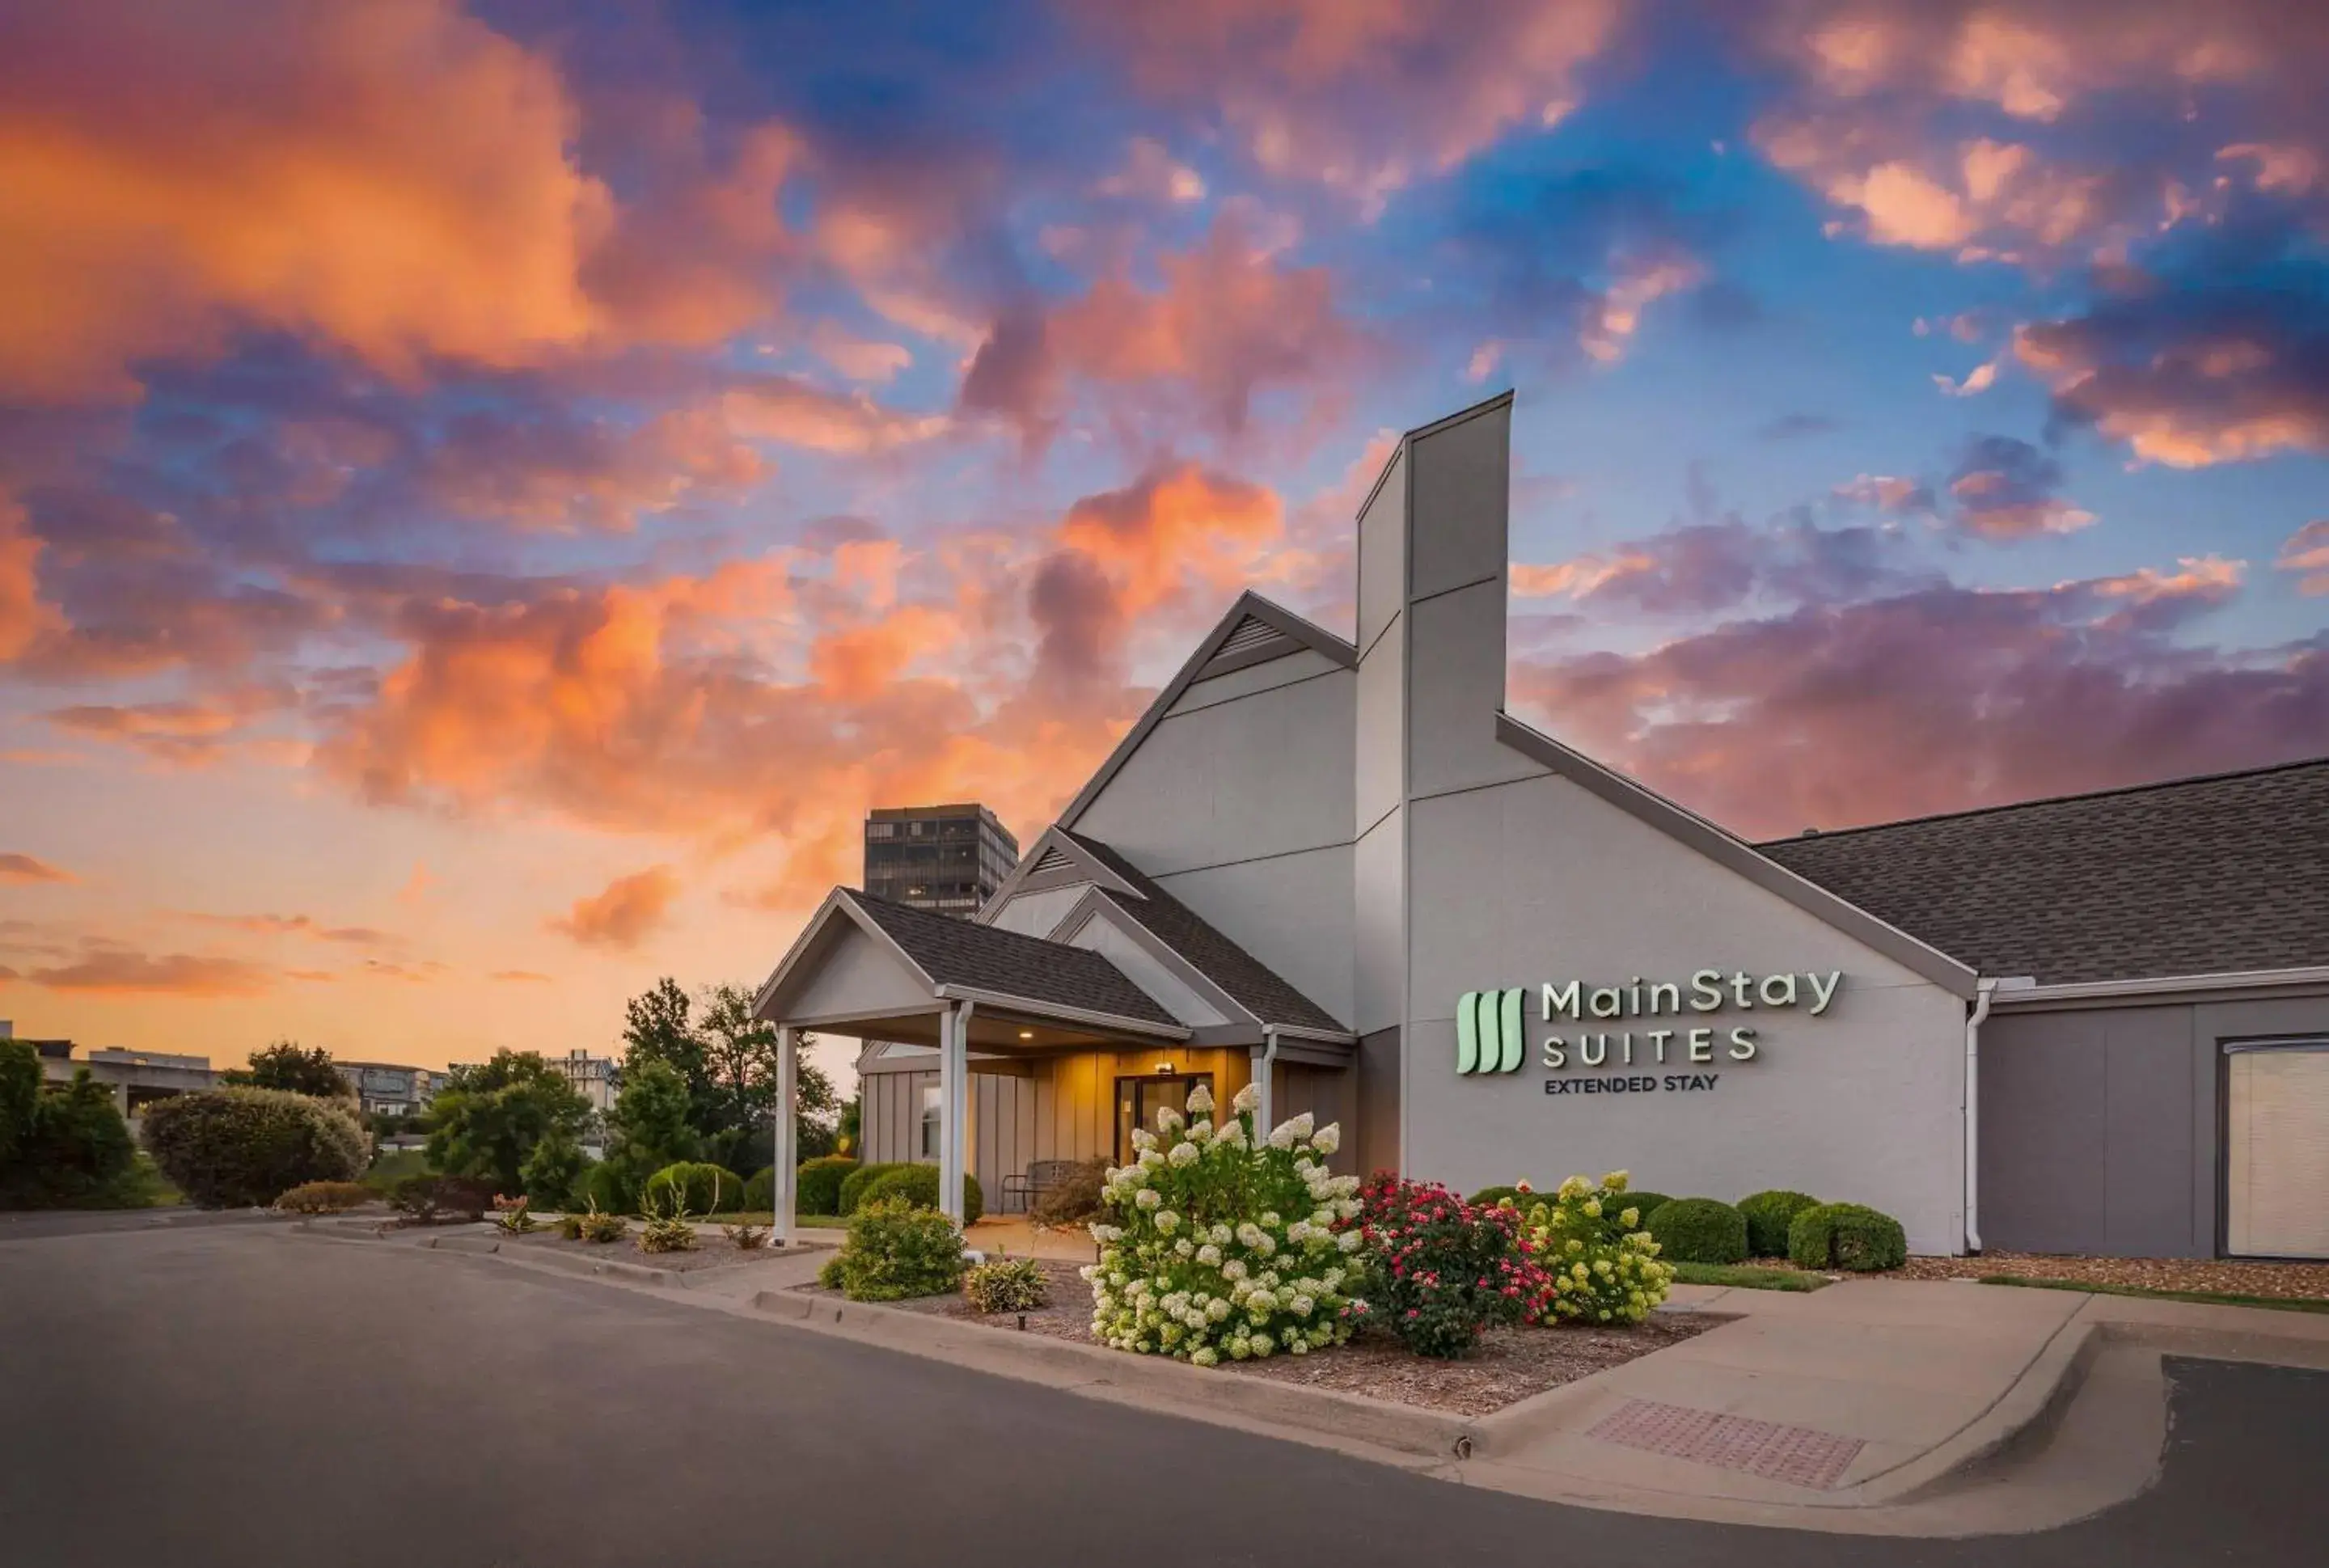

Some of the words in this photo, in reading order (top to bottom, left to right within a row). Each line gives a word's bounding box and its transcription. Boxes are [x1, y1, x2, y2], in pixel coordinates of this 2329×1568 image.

[1541, 969, 1842, 1021] MainStay
[1542, 1027, 1757, 1067] SUITES
[1545, 1076, 1657, 1095] EXTENDED
[1664, 1074, 1719, 1092] STAY
